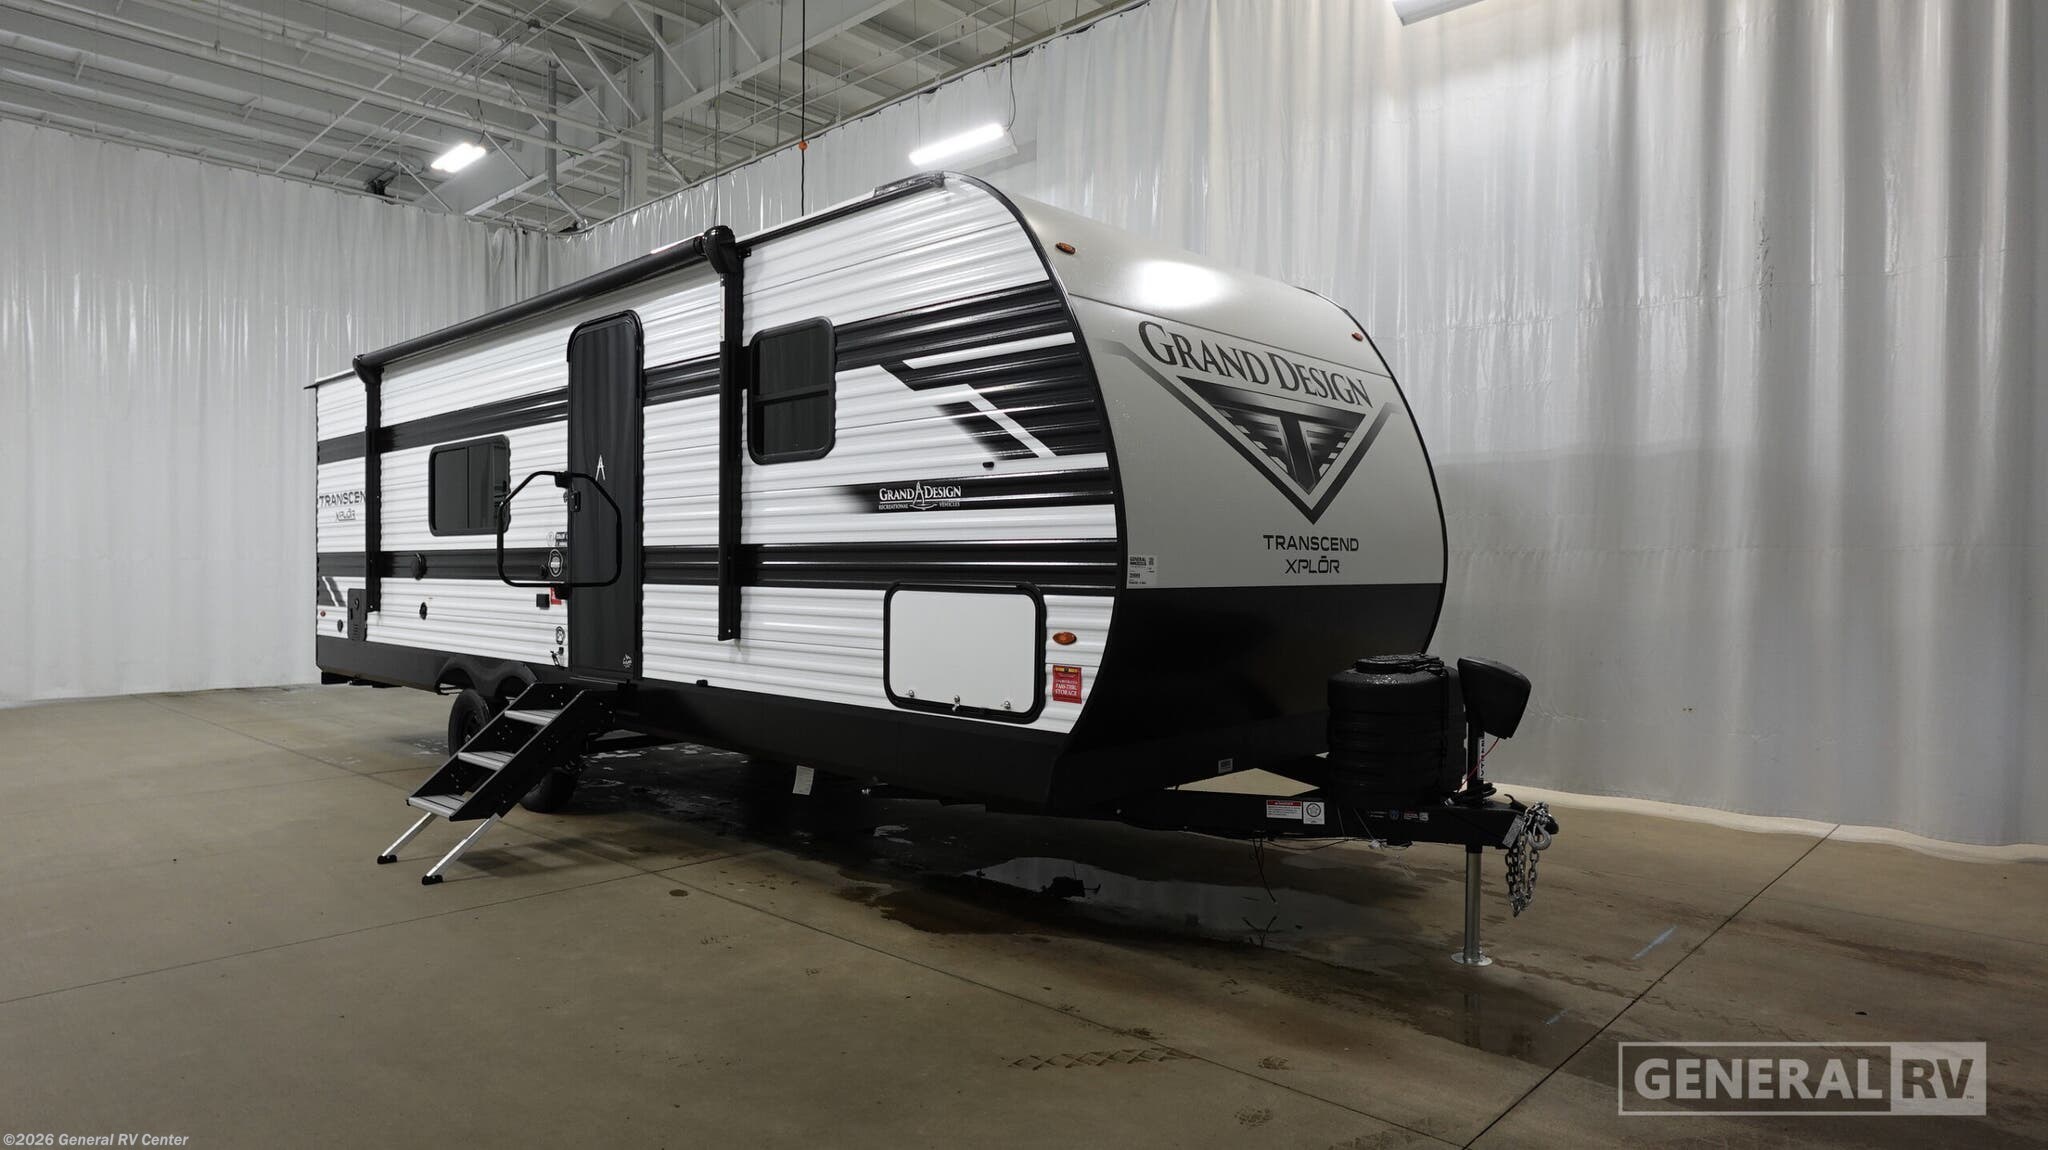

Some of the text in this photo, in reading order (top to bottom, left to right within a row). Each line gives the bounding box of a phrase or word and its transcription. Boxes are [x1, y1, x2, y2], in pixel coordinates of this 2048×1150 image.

[1138, 321, 1374, 408] GRAND DESIGN
[879, 485, 962, 501] GRAND DESIGN
[1263, 534, 1359, 552] TRANSCEND
